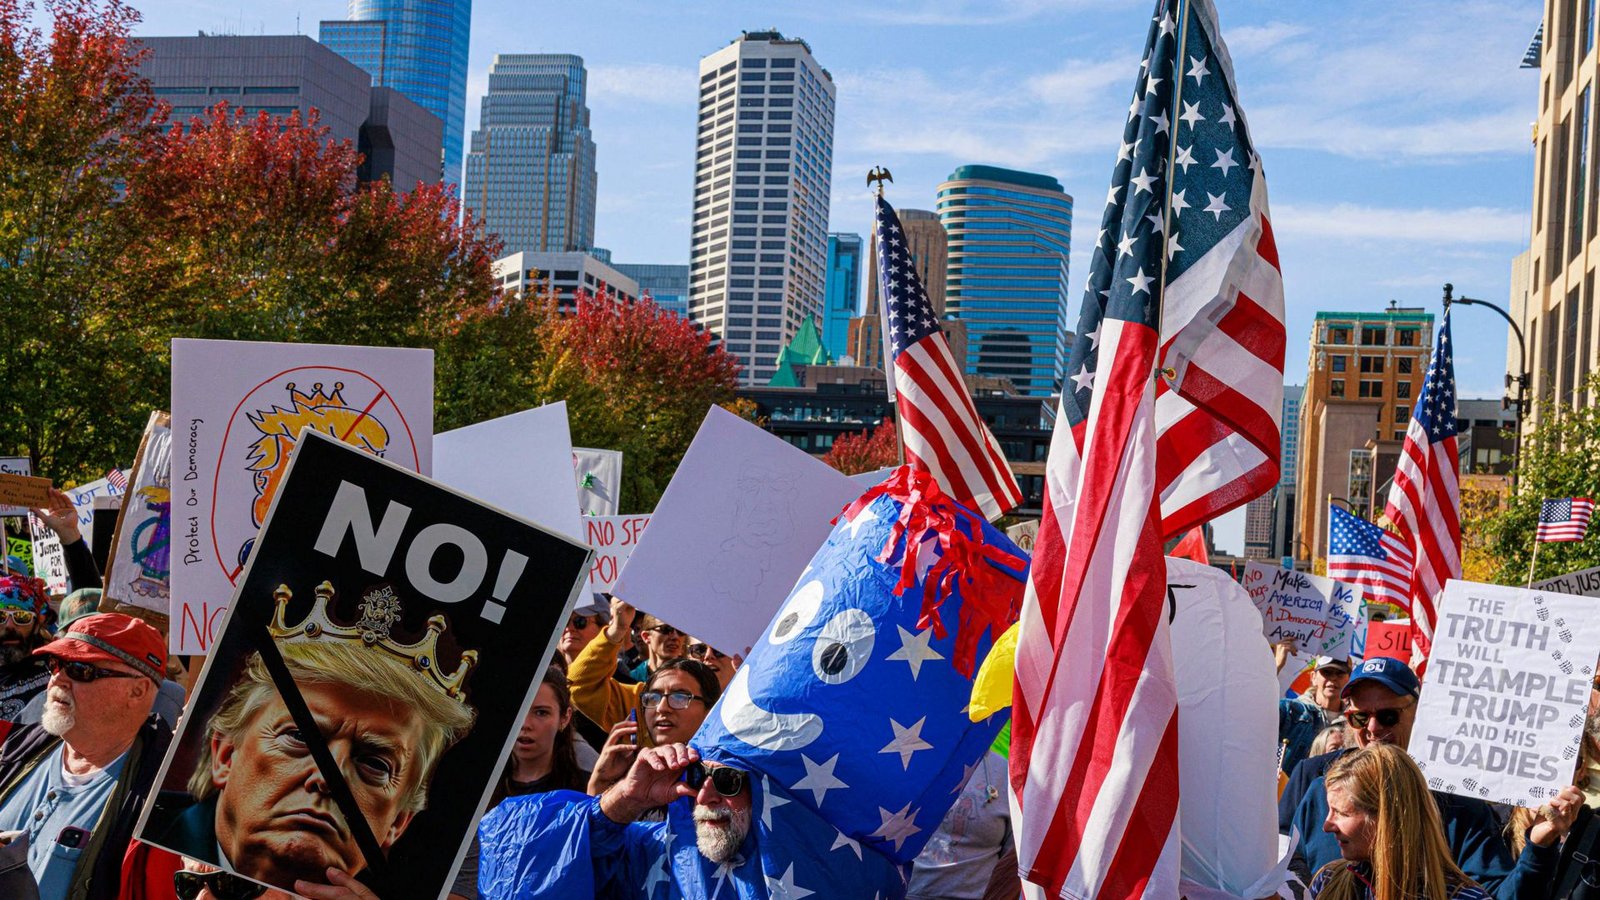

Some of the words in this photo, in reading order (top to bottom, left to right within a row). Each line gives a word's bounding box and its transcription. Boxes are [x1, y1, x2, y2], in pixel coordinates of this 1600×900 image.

[184, 418, 204, 481] Democracy
[186, 488, 199, 506] Our
[184, 516, 202, 566] Protect
[588, 520, 615, 546] NO
[8, 540, 34, 555] Yes
[313, 479, 530, 625] NO!
[51, 568, 63, 577] ALL
[1245, 569, 1262, 584] NO
[1272, 570, 1311, 593] Make
[1334, 586, 1353, 604] No
[1468, 597, 1505, 616] THE
[1265, 606, 1273, 622] A
[1276, 608, 1333, 638] Democracy
[1446, 613, 1550, 651] TRUTH
[1457, 643, 1504, 664] WILL
[1436, 659, 1587, 705] TRAMPLE
[1449, 690, 1560, 730] TRUMP
[1456, 722, 1498, 741] AND
[1504, 728, 1537, 748] HIS
[1427, 735, 1560, 782] TOADIES
